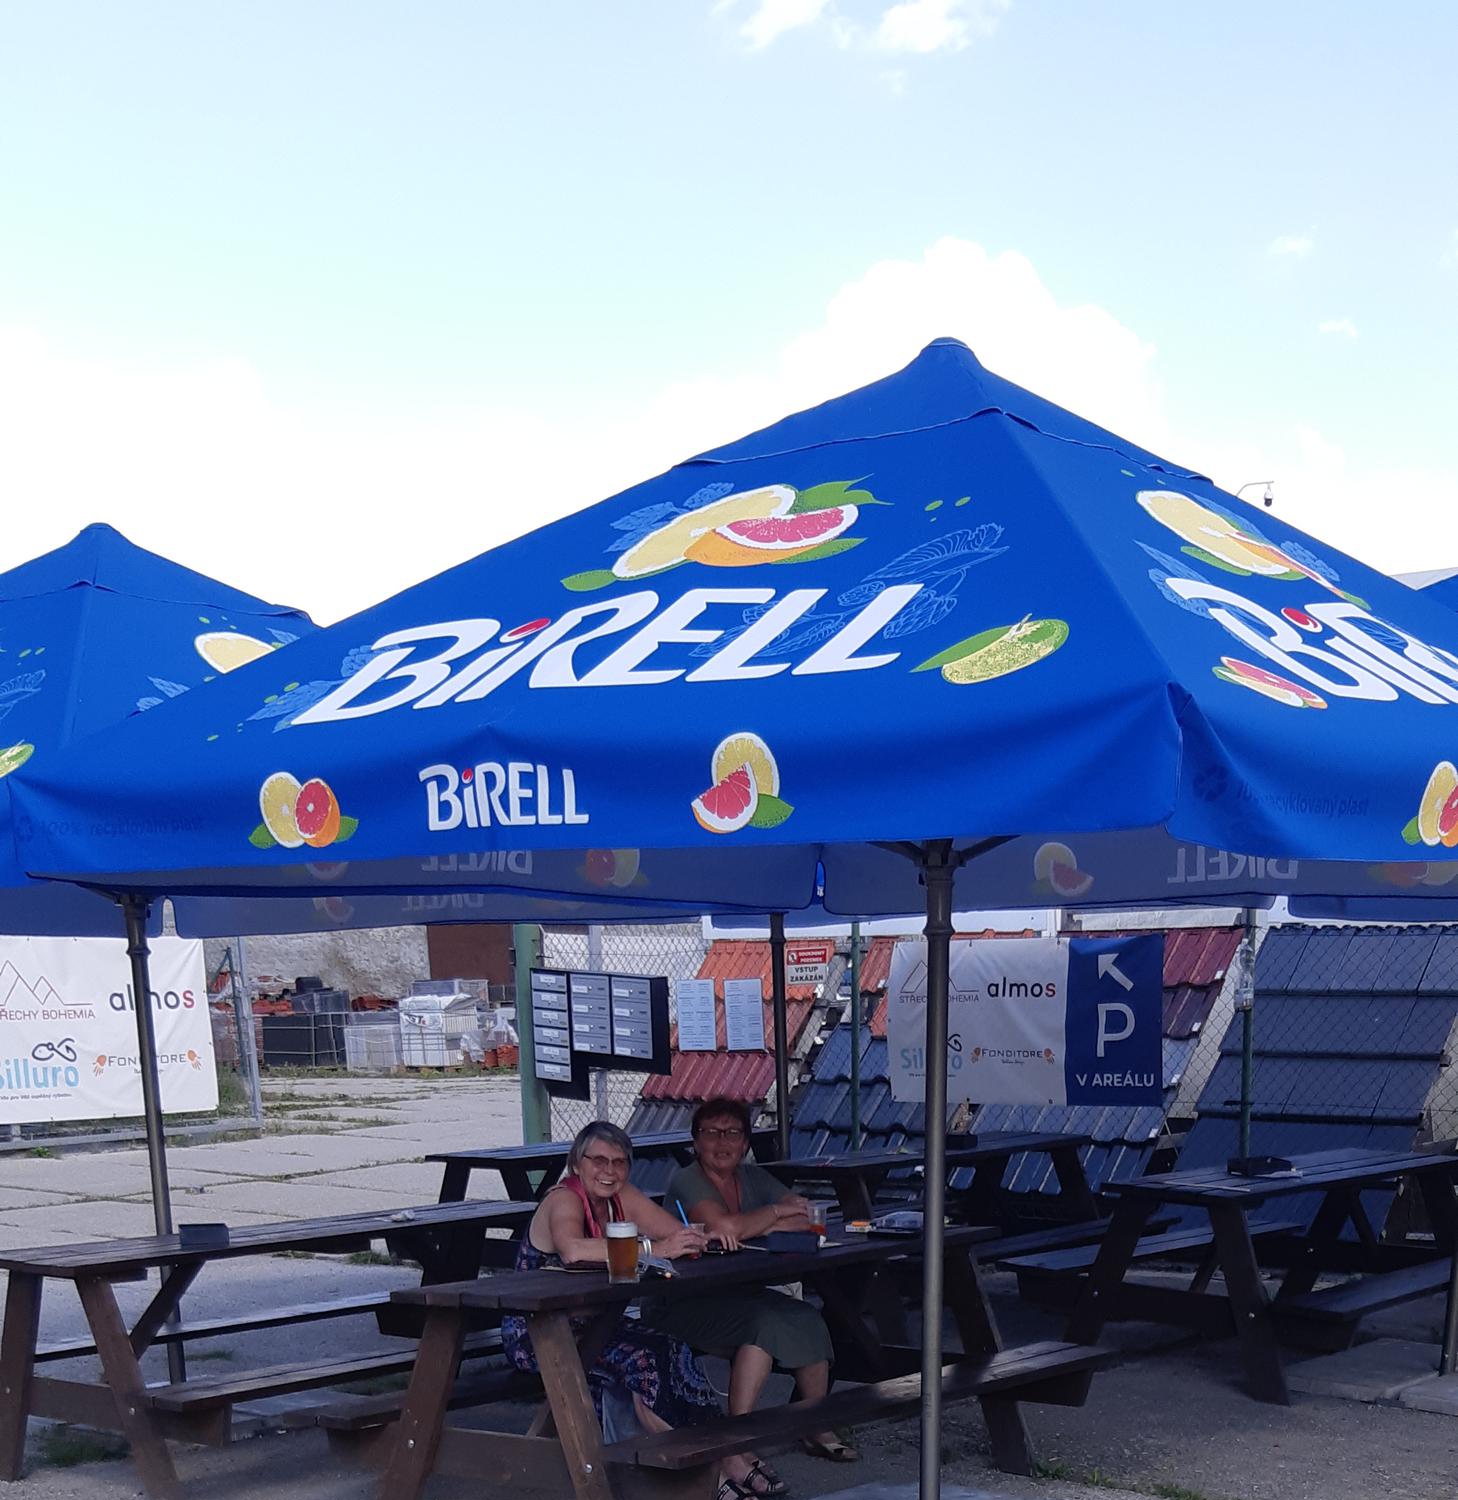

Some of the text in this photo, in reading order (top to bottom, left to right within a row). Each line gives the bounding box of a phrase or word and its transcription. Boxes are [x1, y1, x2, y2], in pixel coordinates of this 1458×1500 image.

[1165, 577, 1458, 704] BiR
[987, 976, 1056, 998] almos
[899, 994, 927, 1004] STŘEC
[42, 1009, 96, 1020] BOHEMIA
[1096, 1002, 1136, 1057] P
[108, 1053, 186, 1067] FONORE
[901, 1049, 963, 1070] Silo
[981, 1048, 1043, 1058] FONDITORE
[1075, 1070, 1155, 1087] V AREÁLU
